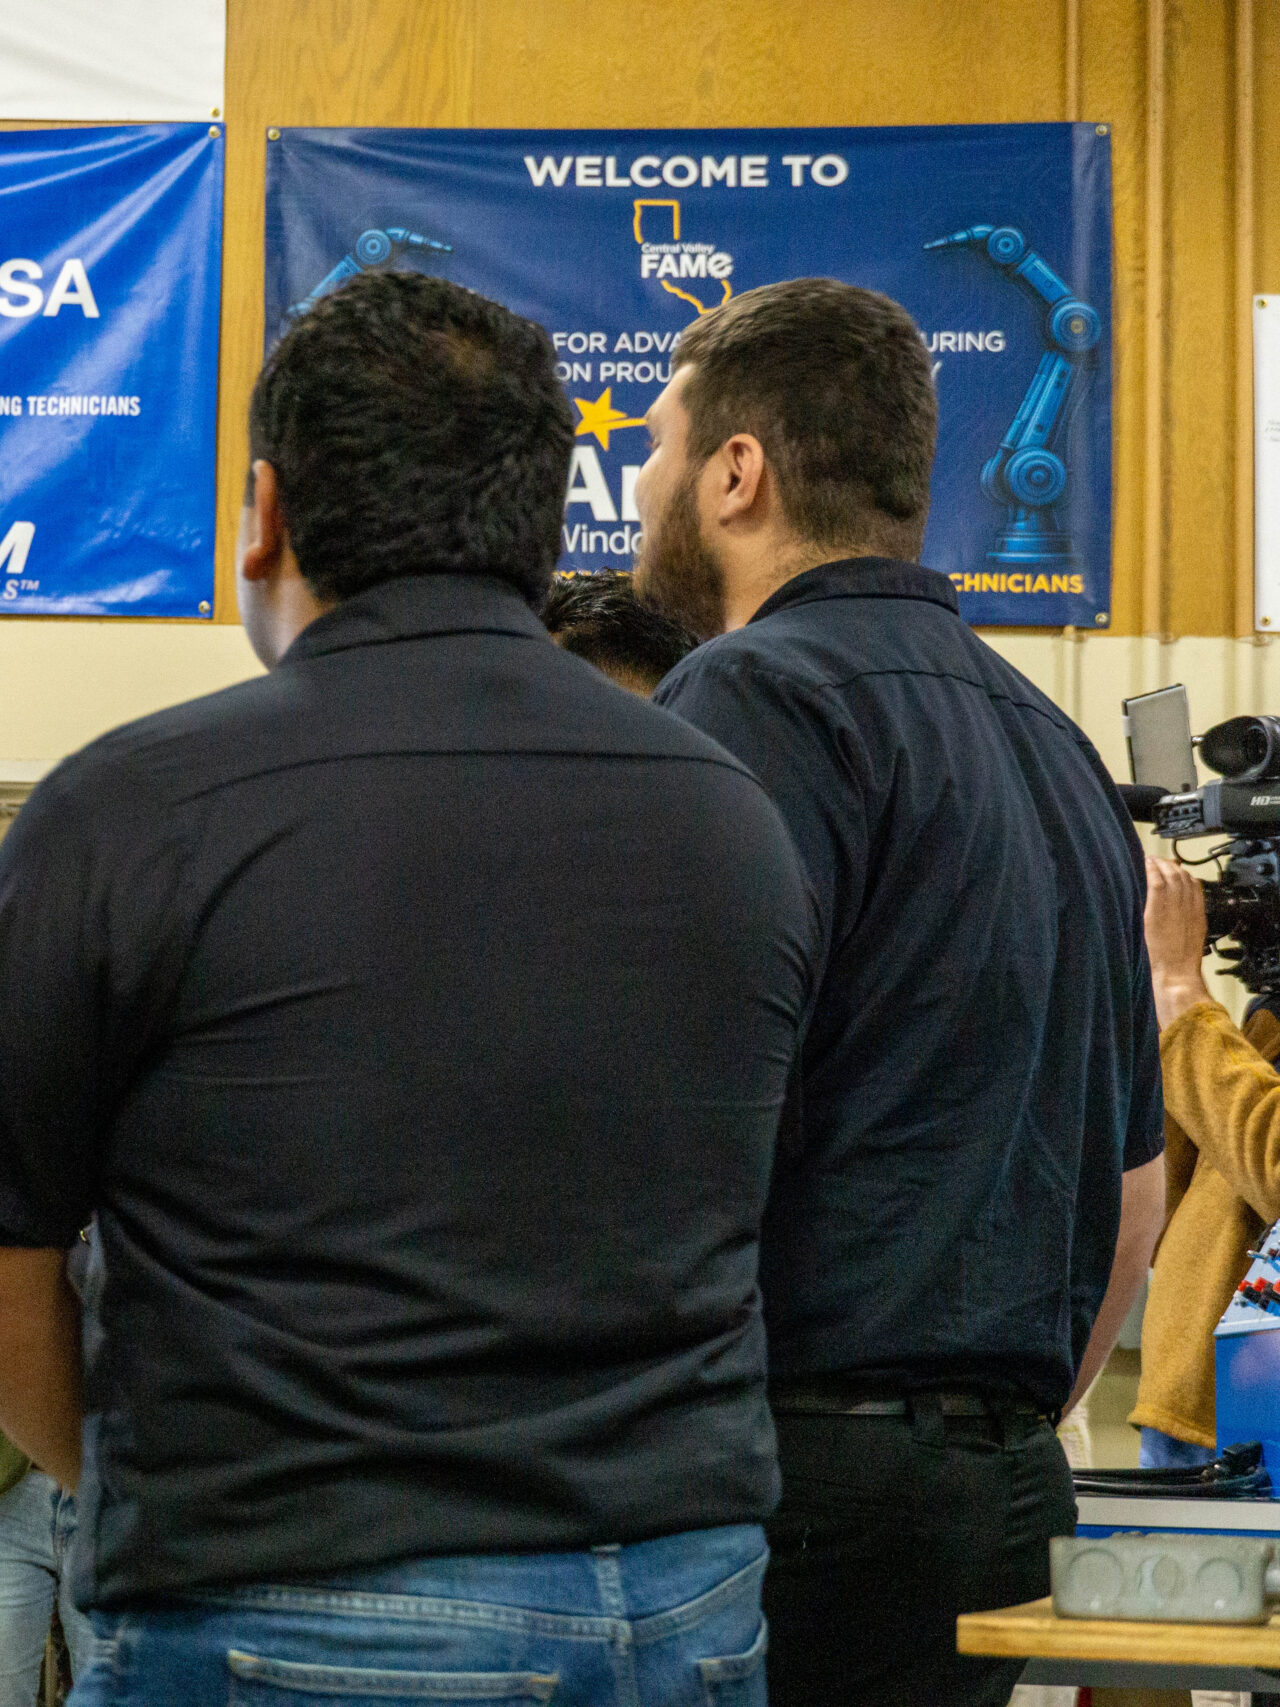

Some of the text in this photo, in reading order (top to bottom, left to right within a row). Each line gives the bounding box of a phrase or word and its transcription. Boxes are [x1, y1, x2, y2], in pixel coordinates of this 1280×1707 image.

[524, 154, 849, 187] WELCOME TO
[641, 243, 715, 257] Central Valley
[552, 331, 608, 354] FOR
[27, 395, 141, 417] TECHNICIANS
